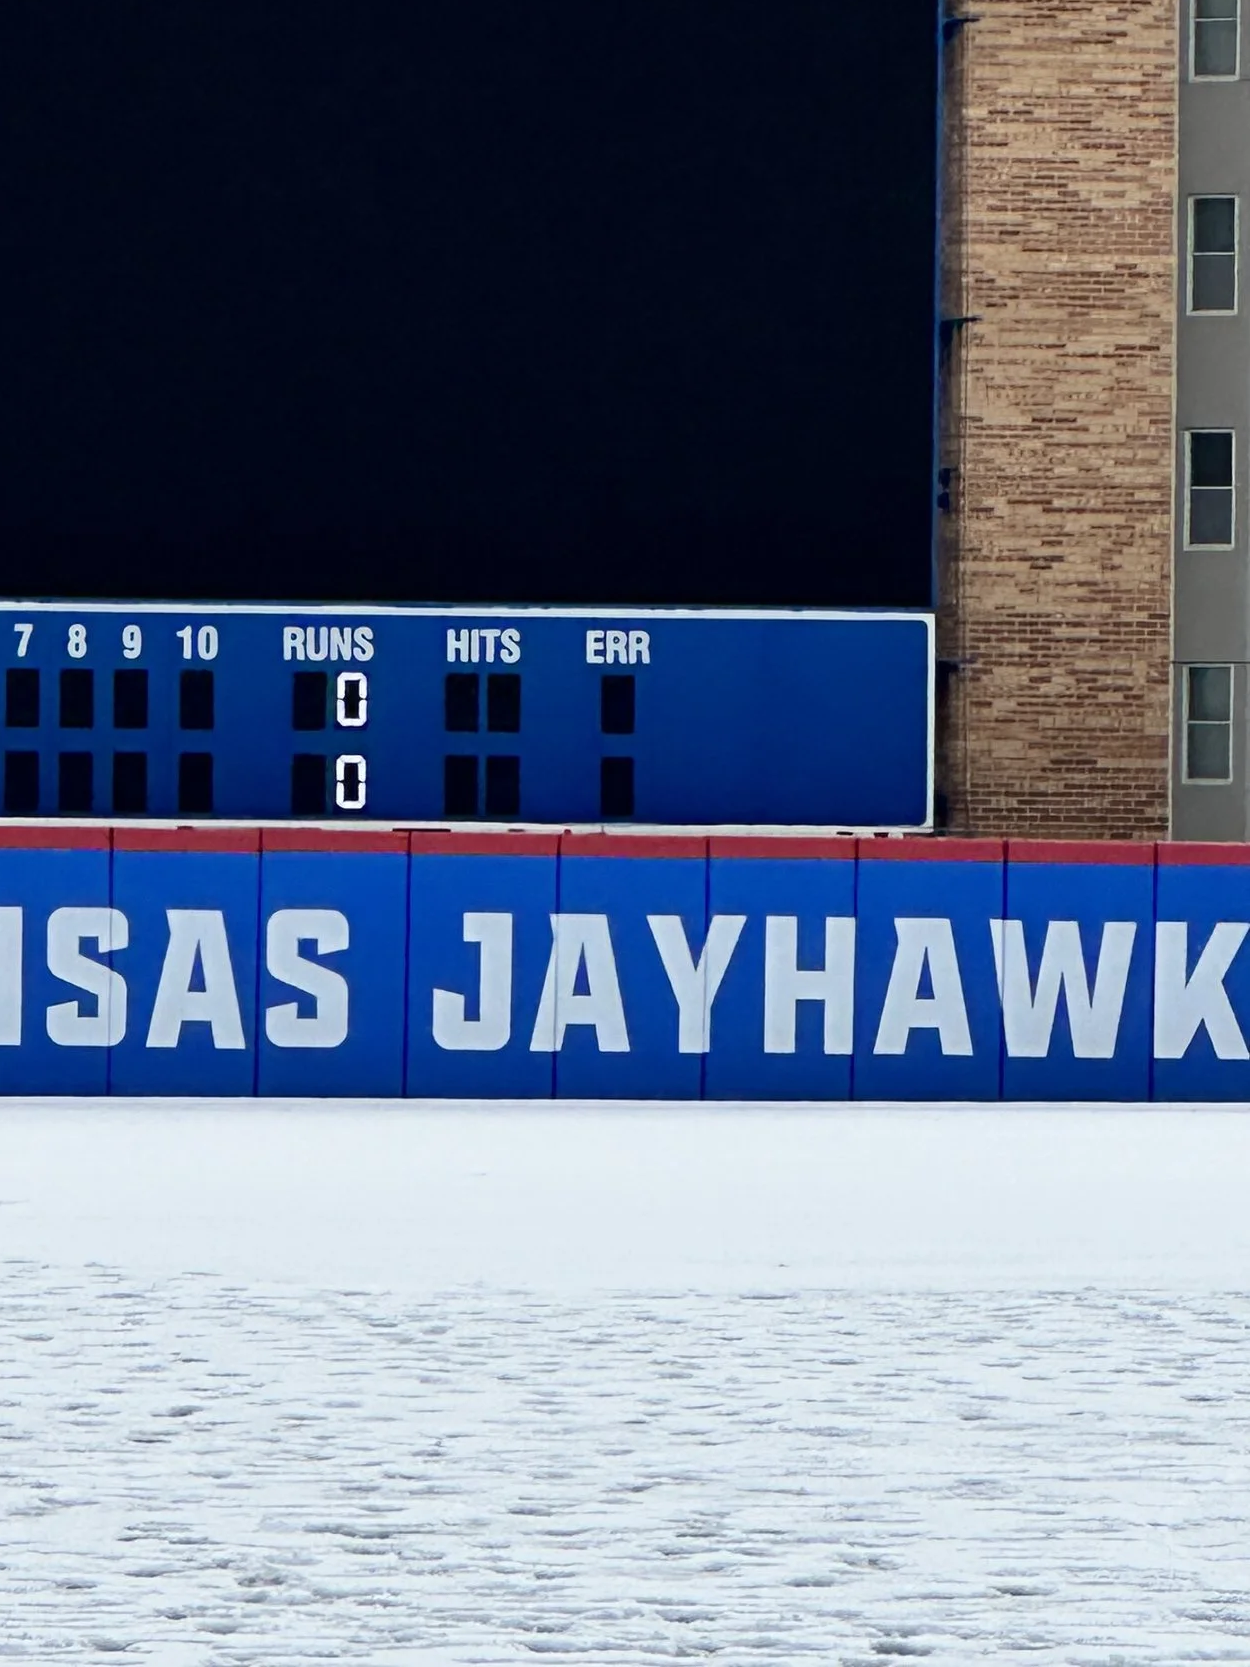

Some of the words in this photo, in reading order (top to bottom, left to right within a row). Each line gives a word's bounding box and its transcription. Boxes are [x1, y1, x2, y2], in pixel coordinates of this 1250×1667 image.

[14, 623, 34, 657] 7
[67, 623, 87, 659] 8
[122, 624, 142, 659] 9
[176, 625, 219, 661] 10
[283, 626, 375, 662] RUNS
[446, 628, 521, 664] HITS
[586, 629, 651, 664] ERR
[336, 671, 368, 727] 0
[335, 754, 367, 810] 0
[432, 912, 1250, 1060] JAYHAWK
